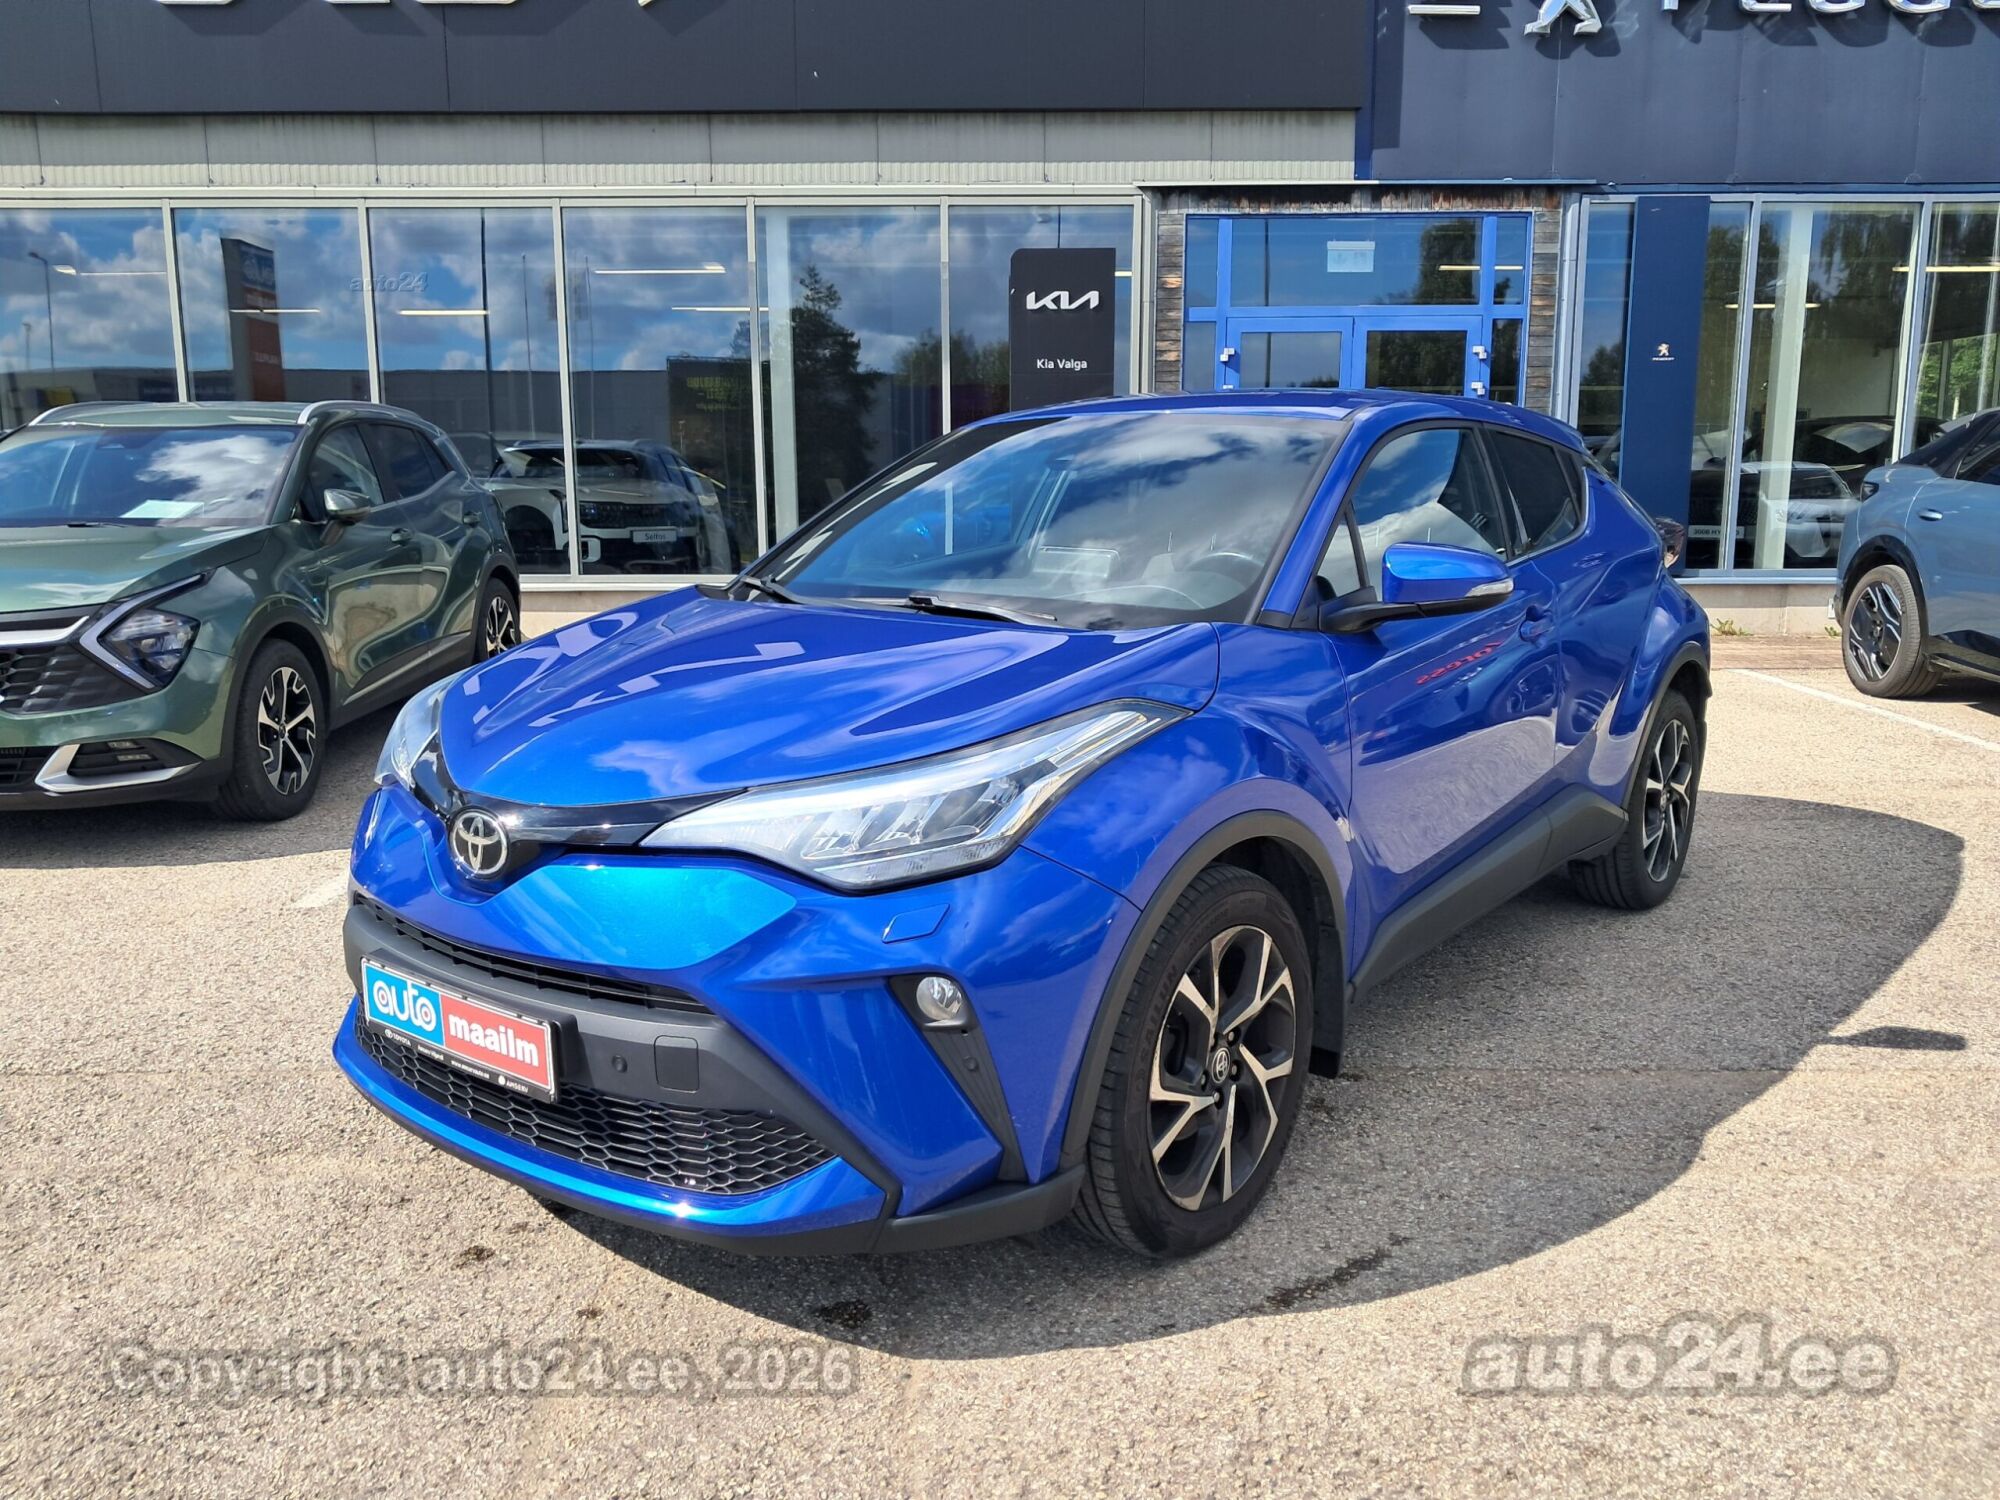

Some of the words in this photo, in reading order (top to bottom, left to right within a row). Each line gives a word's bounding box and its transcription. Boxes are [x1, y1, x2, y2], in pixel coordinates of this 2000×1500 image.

[1036, 358, 1055, 369] Kia
[1057, 358, 1088, 371] Valga
[372, 980, 437, 1032] auto
[448, 1013, 540, 1068] maailm
